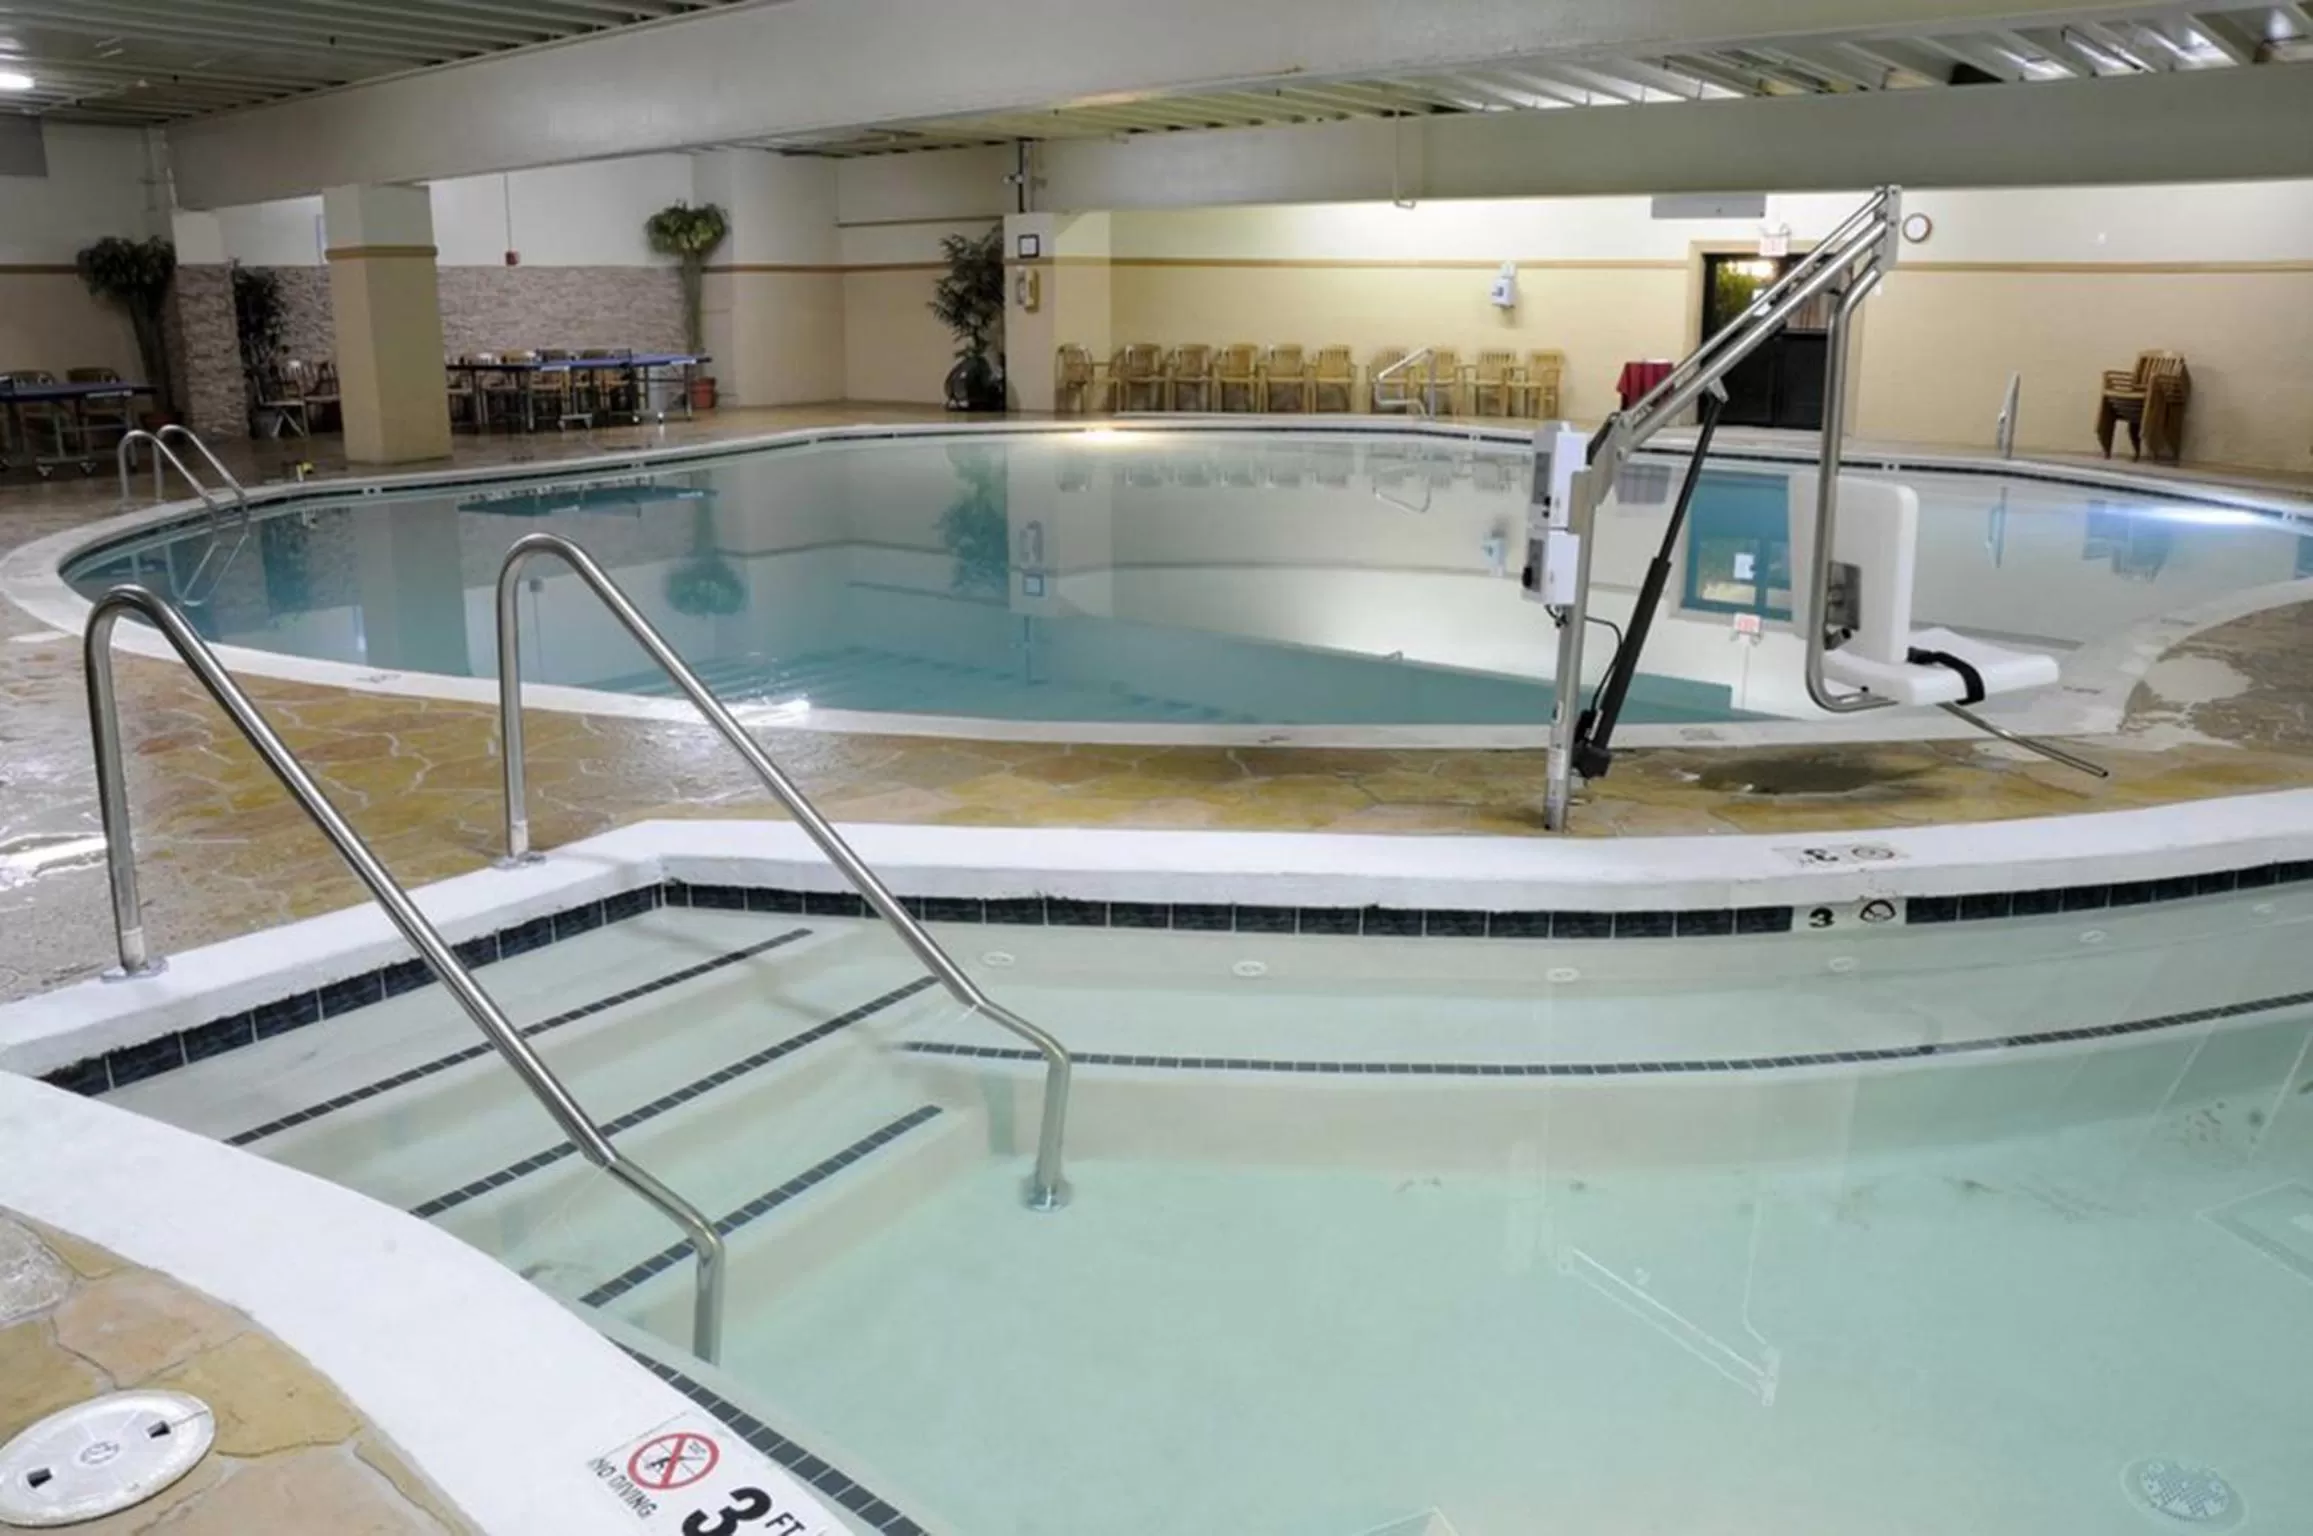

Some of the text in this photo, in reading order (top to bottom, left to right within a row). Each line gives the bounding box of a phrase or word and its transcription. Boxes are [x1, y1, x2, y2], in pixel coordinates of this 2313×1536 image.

[1809, 907, 1834, 928] 3
[585, 1457, 657, 1520] NO DIVING
[682, 1487, 806, 1536] 3 FT
